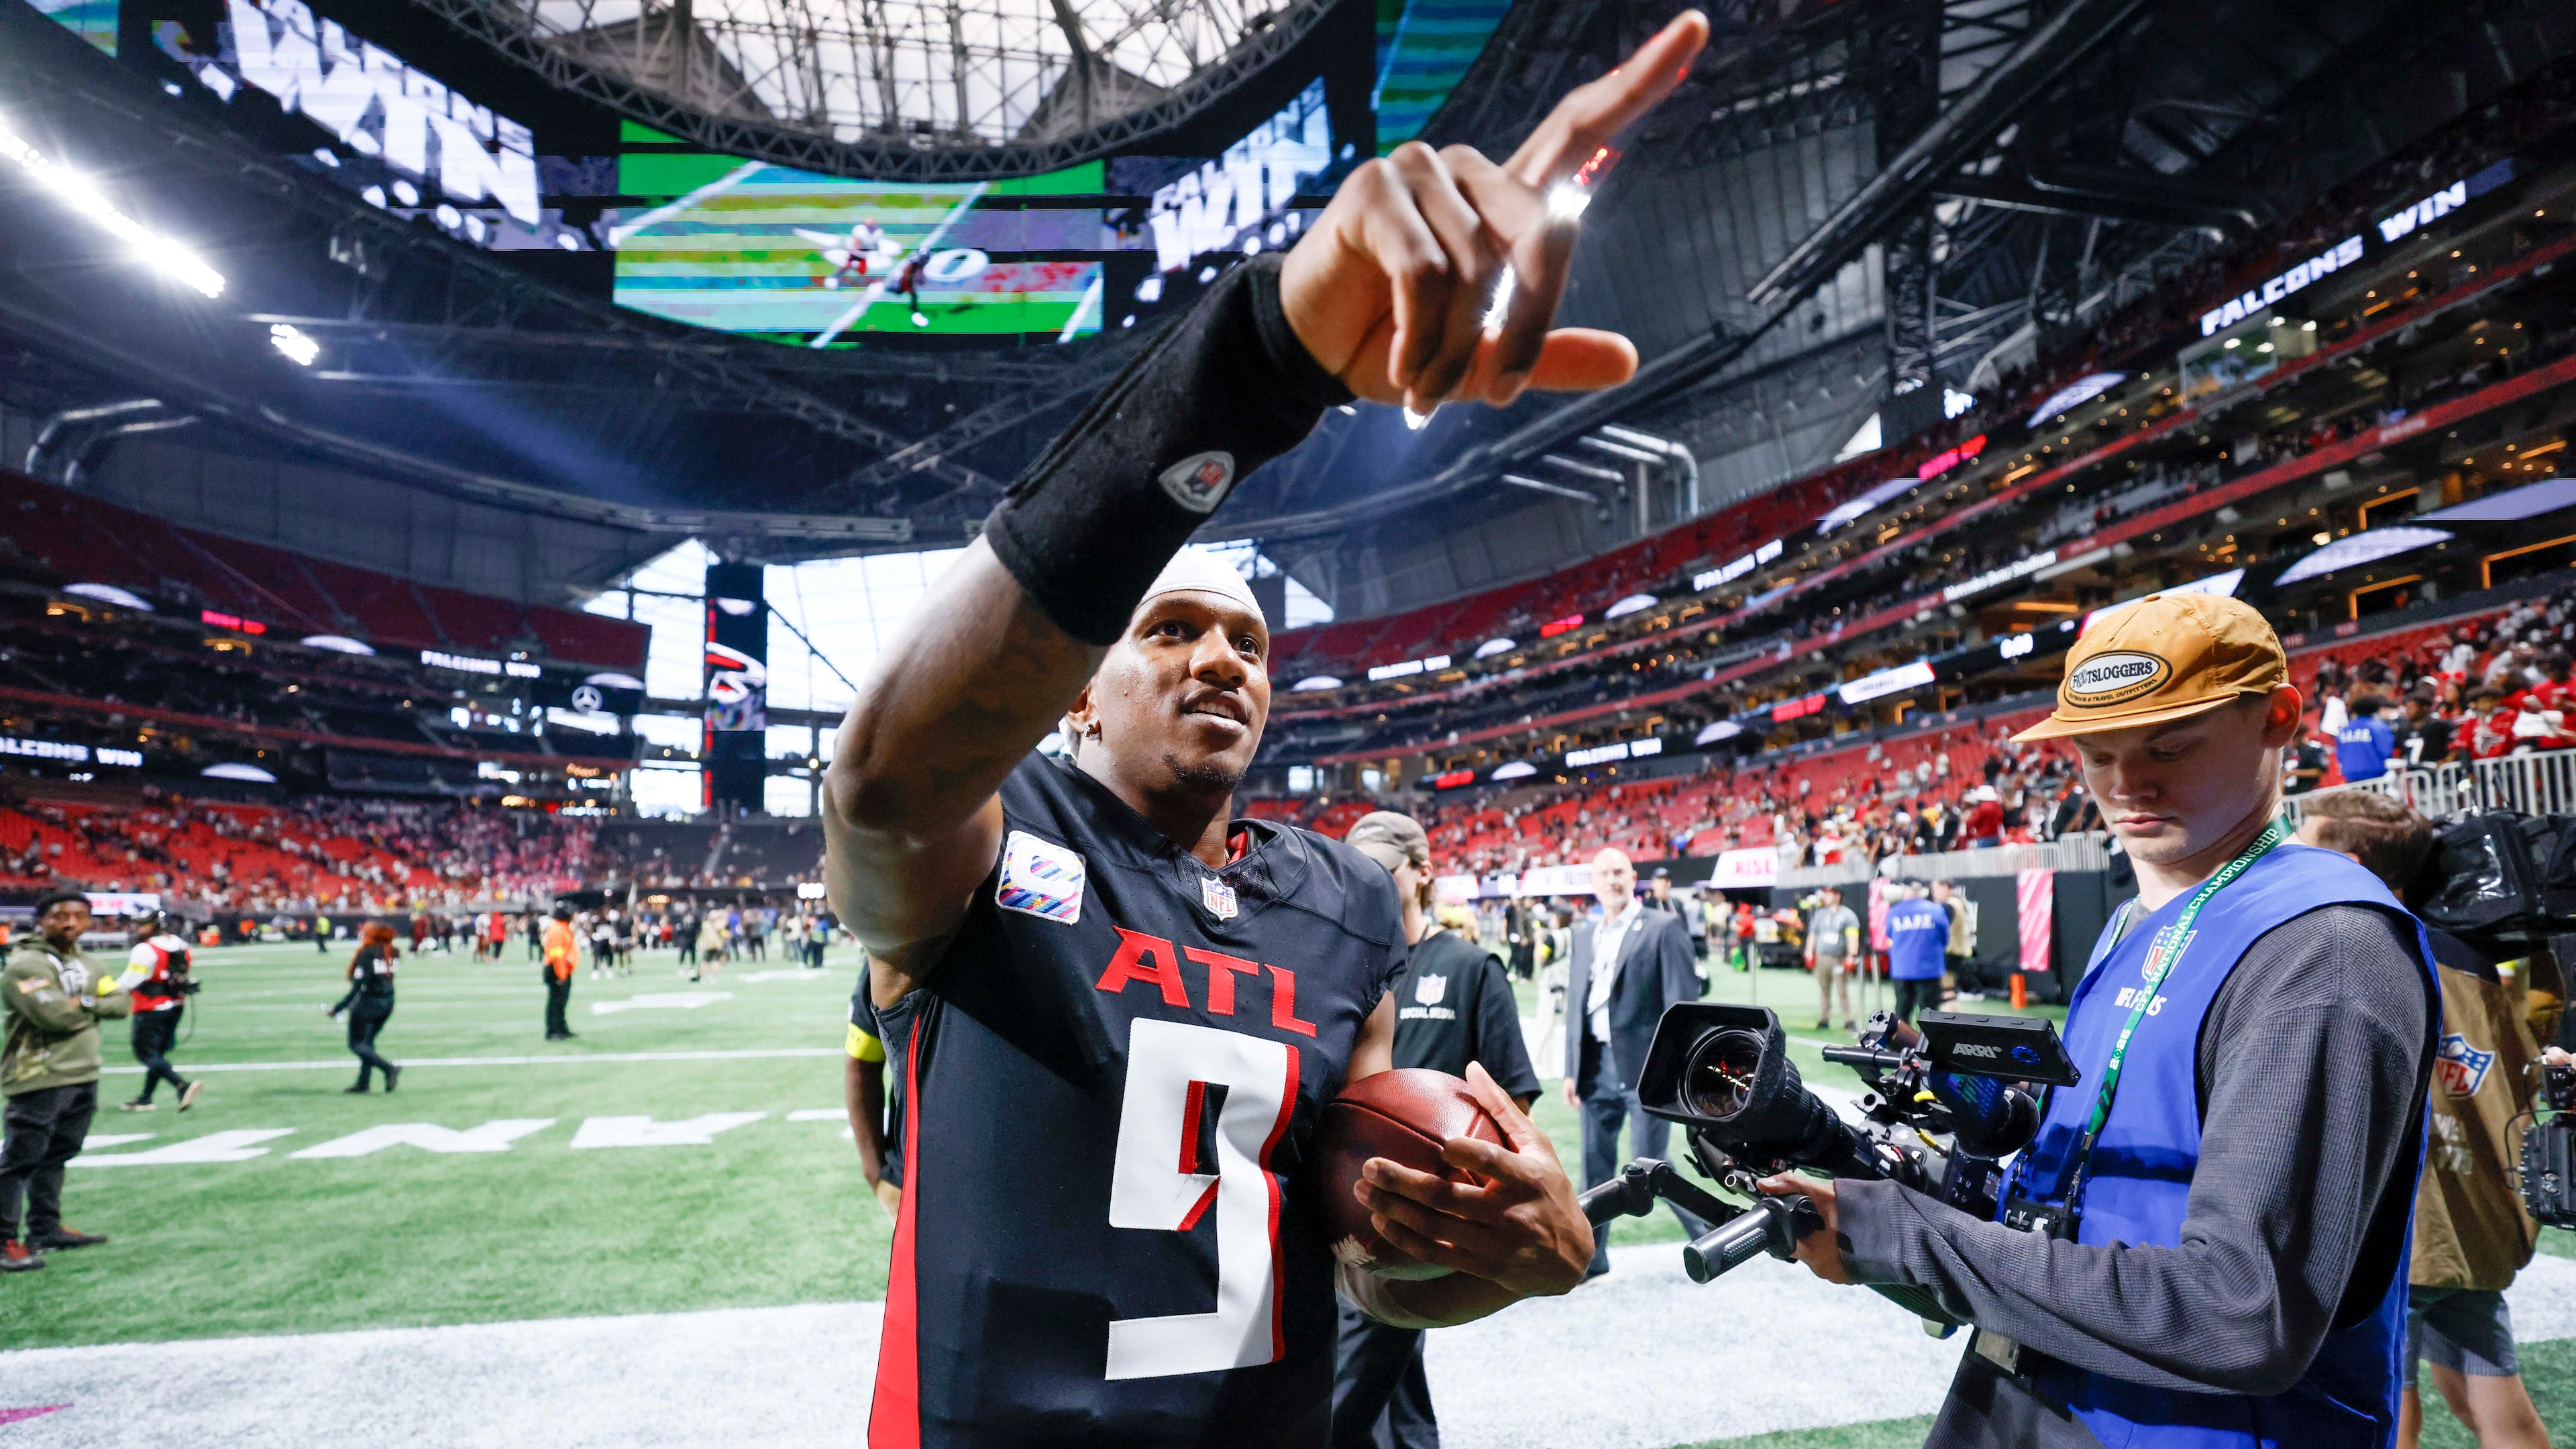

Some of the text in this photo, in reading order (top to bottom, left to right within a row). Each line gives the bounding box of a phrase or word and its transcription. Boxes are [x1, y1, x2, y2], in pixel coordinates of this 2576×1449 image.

[2200, 178, 2467, 337] FALCONS WIN
[2092, 694, 2115, 702] TRAVEL
[2115, 678, 2158, 698] OUTFITTERS
[95, 746, 144, 767] WIN
[1210, 896, 1233, 913] NFL
[2135, 985, 2153, 1012] CFP
[2149, 911, 2195, 983] NATIONAL
[2188, 827, 2280, 910] CHAMPIONSHIP
[1094, 924, 1318, 1038] ATL
[2114, 987, 2137, 1008] NFL
[1399, 1007, 1429, 1020] SOCIAL
[1951, 1042, 1997, 1059] ARRI
[1105, 1016, 1300, 1382] 9
